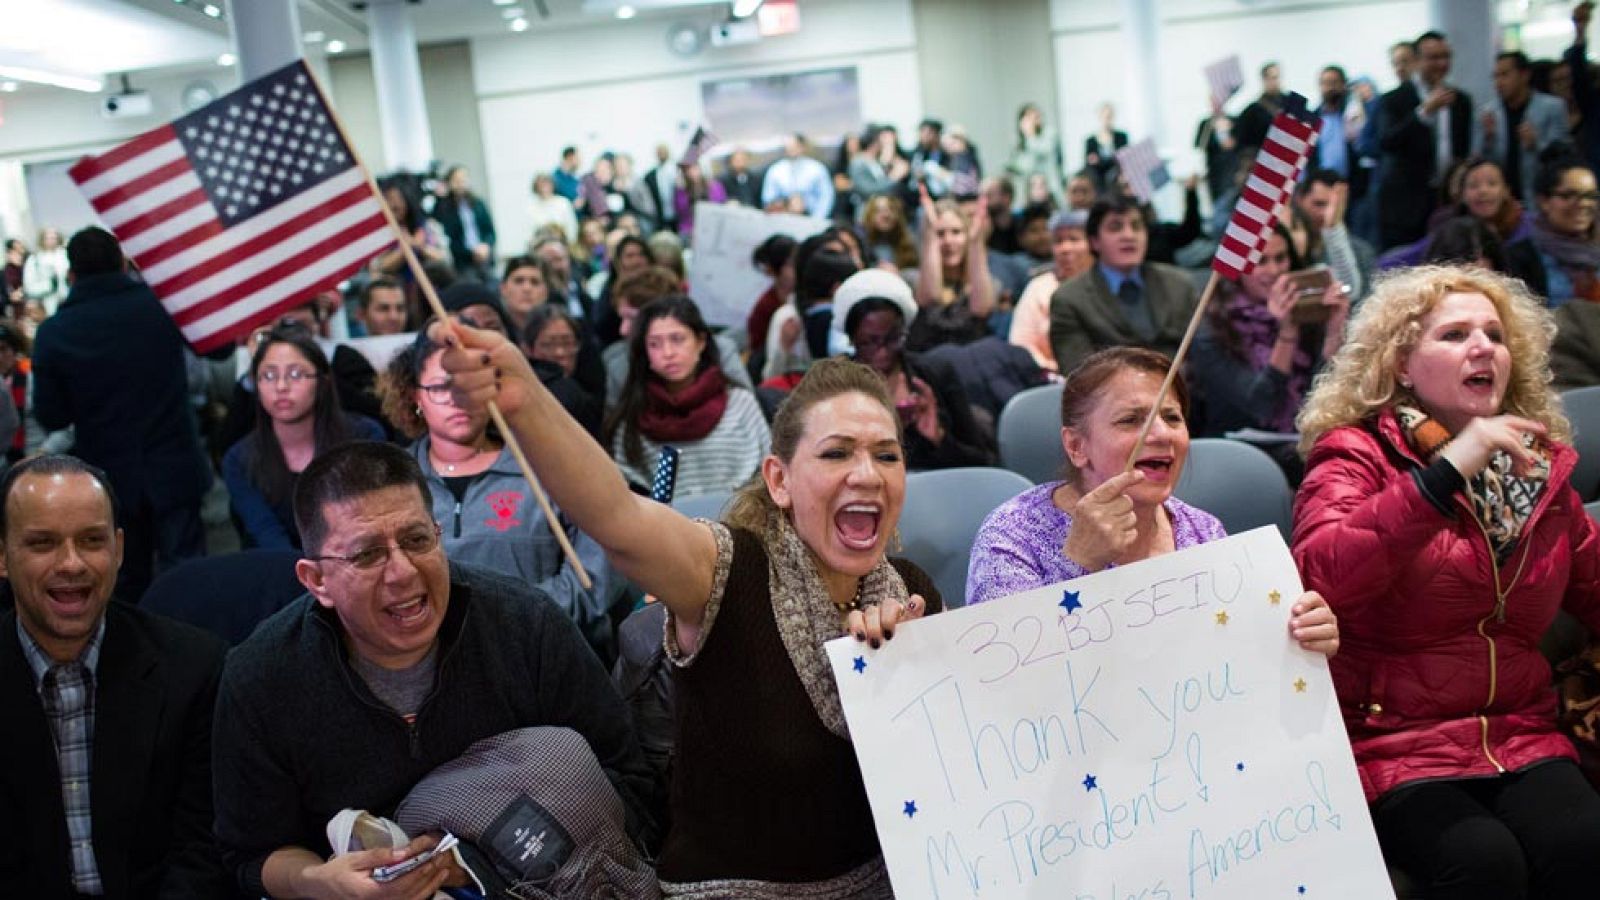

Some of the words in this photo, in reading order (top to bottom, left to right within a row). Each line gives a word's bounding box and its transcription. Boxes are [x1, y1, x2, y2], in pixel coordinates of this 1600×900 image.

[891, 660, 1120, 803] Thank
[1138, 662, 1245, 761] you
[978, 731, 1209, 878] President!
[1188, 760, 1342, 898] America!
